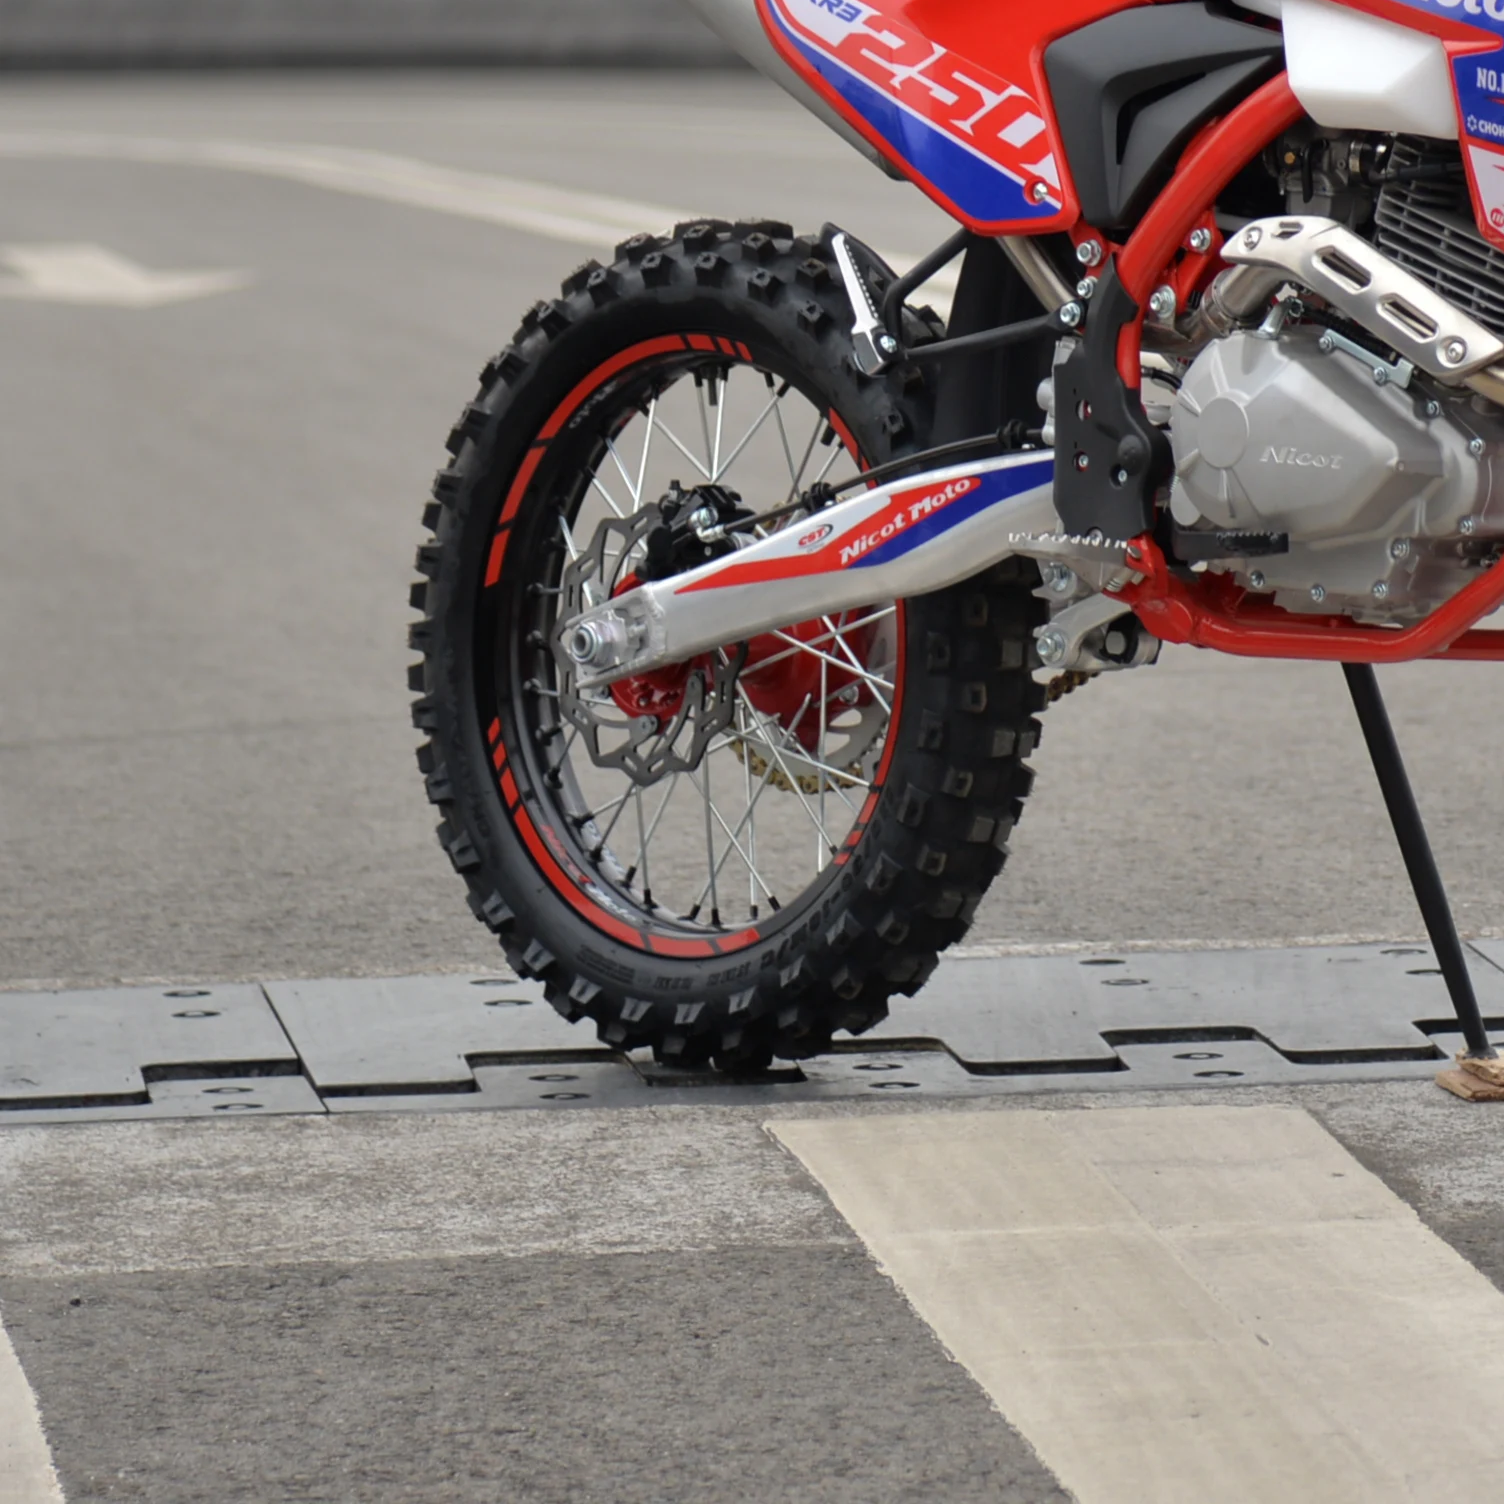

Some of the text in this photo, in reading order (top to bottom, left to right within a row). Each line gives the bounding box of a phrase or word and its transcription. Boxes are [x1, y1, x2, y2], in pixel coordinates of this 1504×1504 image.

[835, 14, 1054, 170] 250
[1259, 445, 1343, 469] Nicot
[839, 479, 970, 565] Nicot Moto
